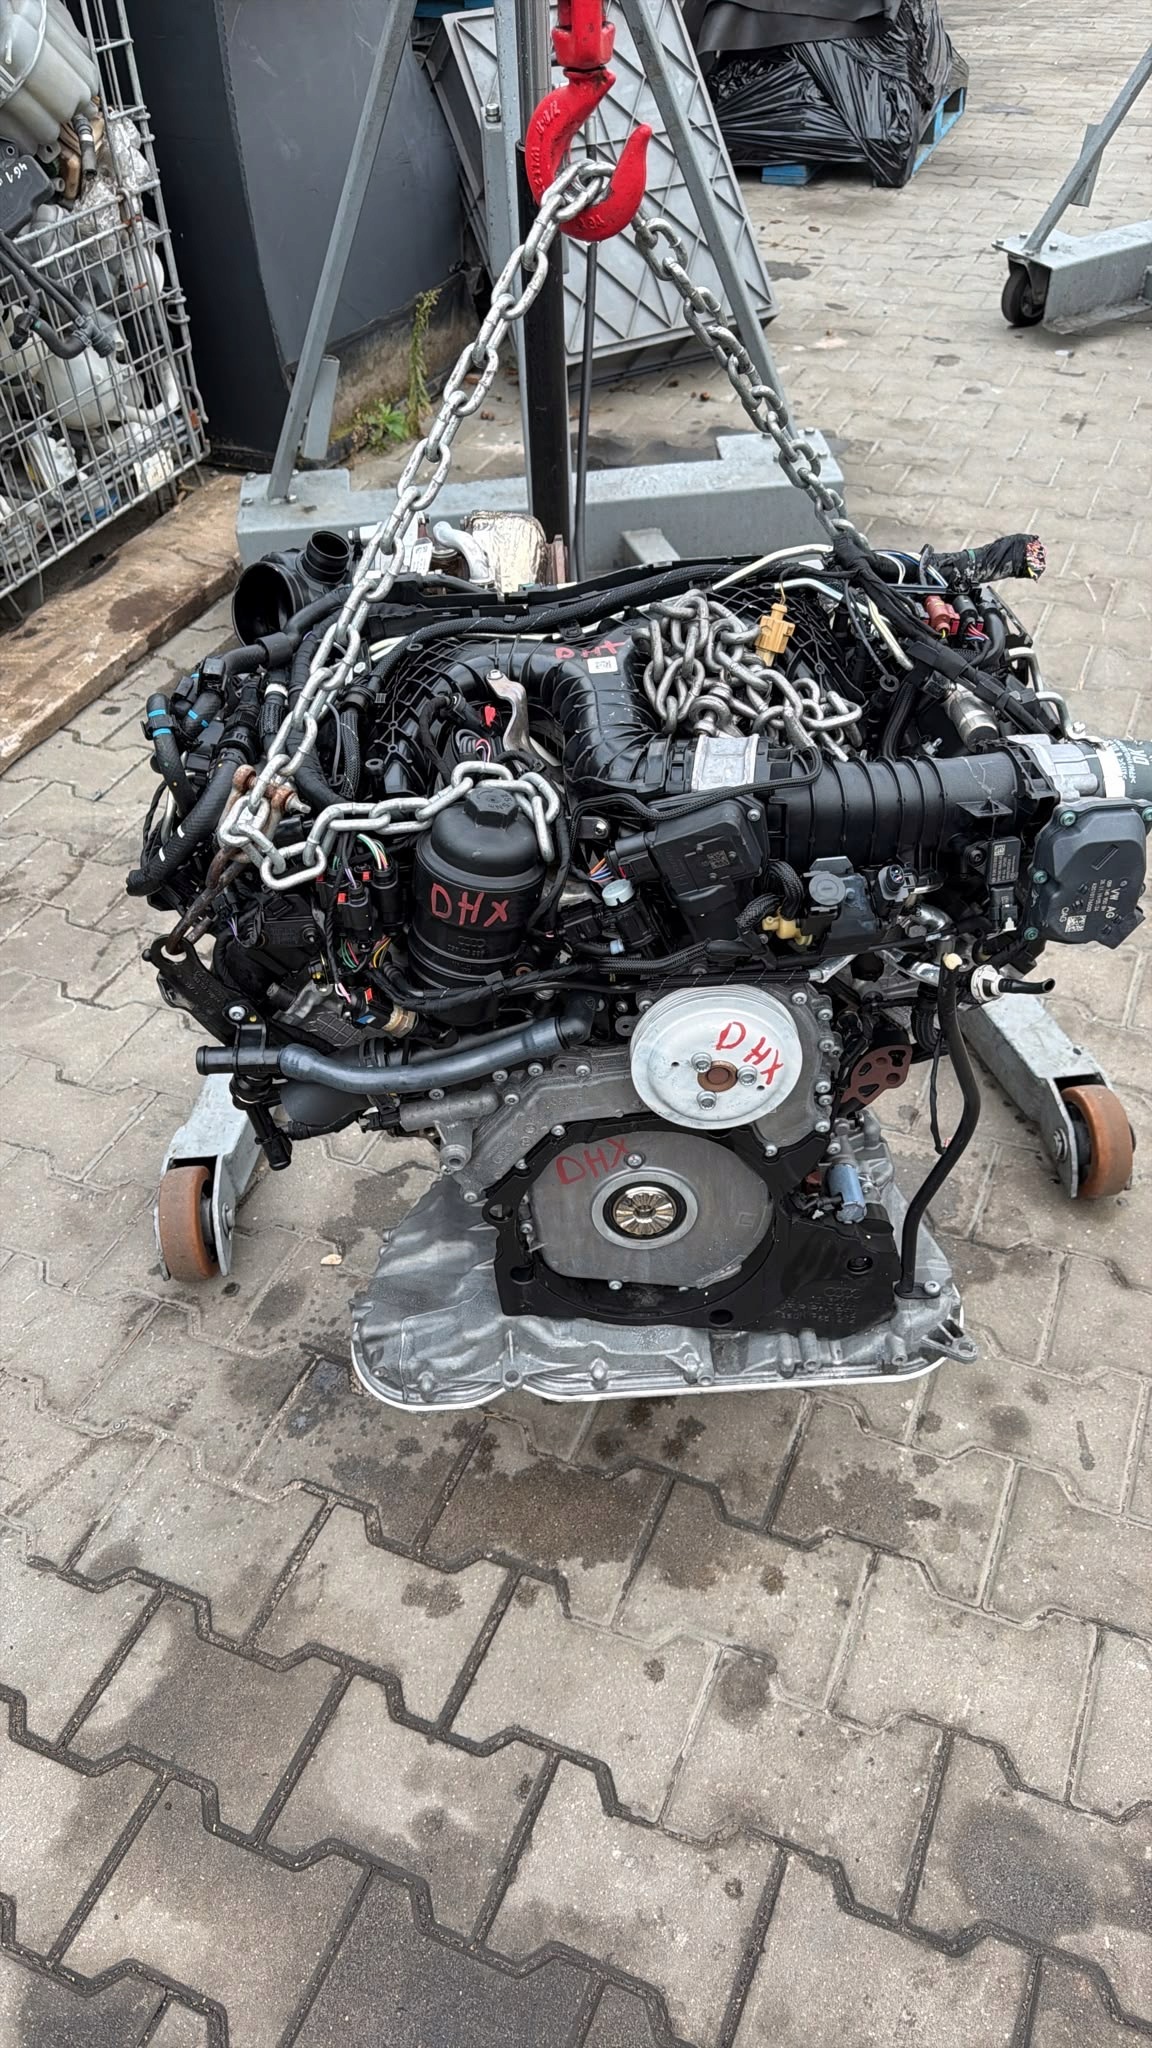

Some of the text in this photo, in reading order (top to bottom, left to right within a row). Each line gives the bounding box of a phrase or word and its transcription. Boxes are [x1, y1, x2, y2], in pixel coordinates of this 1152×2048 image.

[431, 883, 509, 927] DHX
[1059, 906, 1070, 923] CAG
[1106, 888, 1121, 919] VW AG
[715, 1021, 784, 1085] DHX
[555, 1136, 630, 1185] DHX
